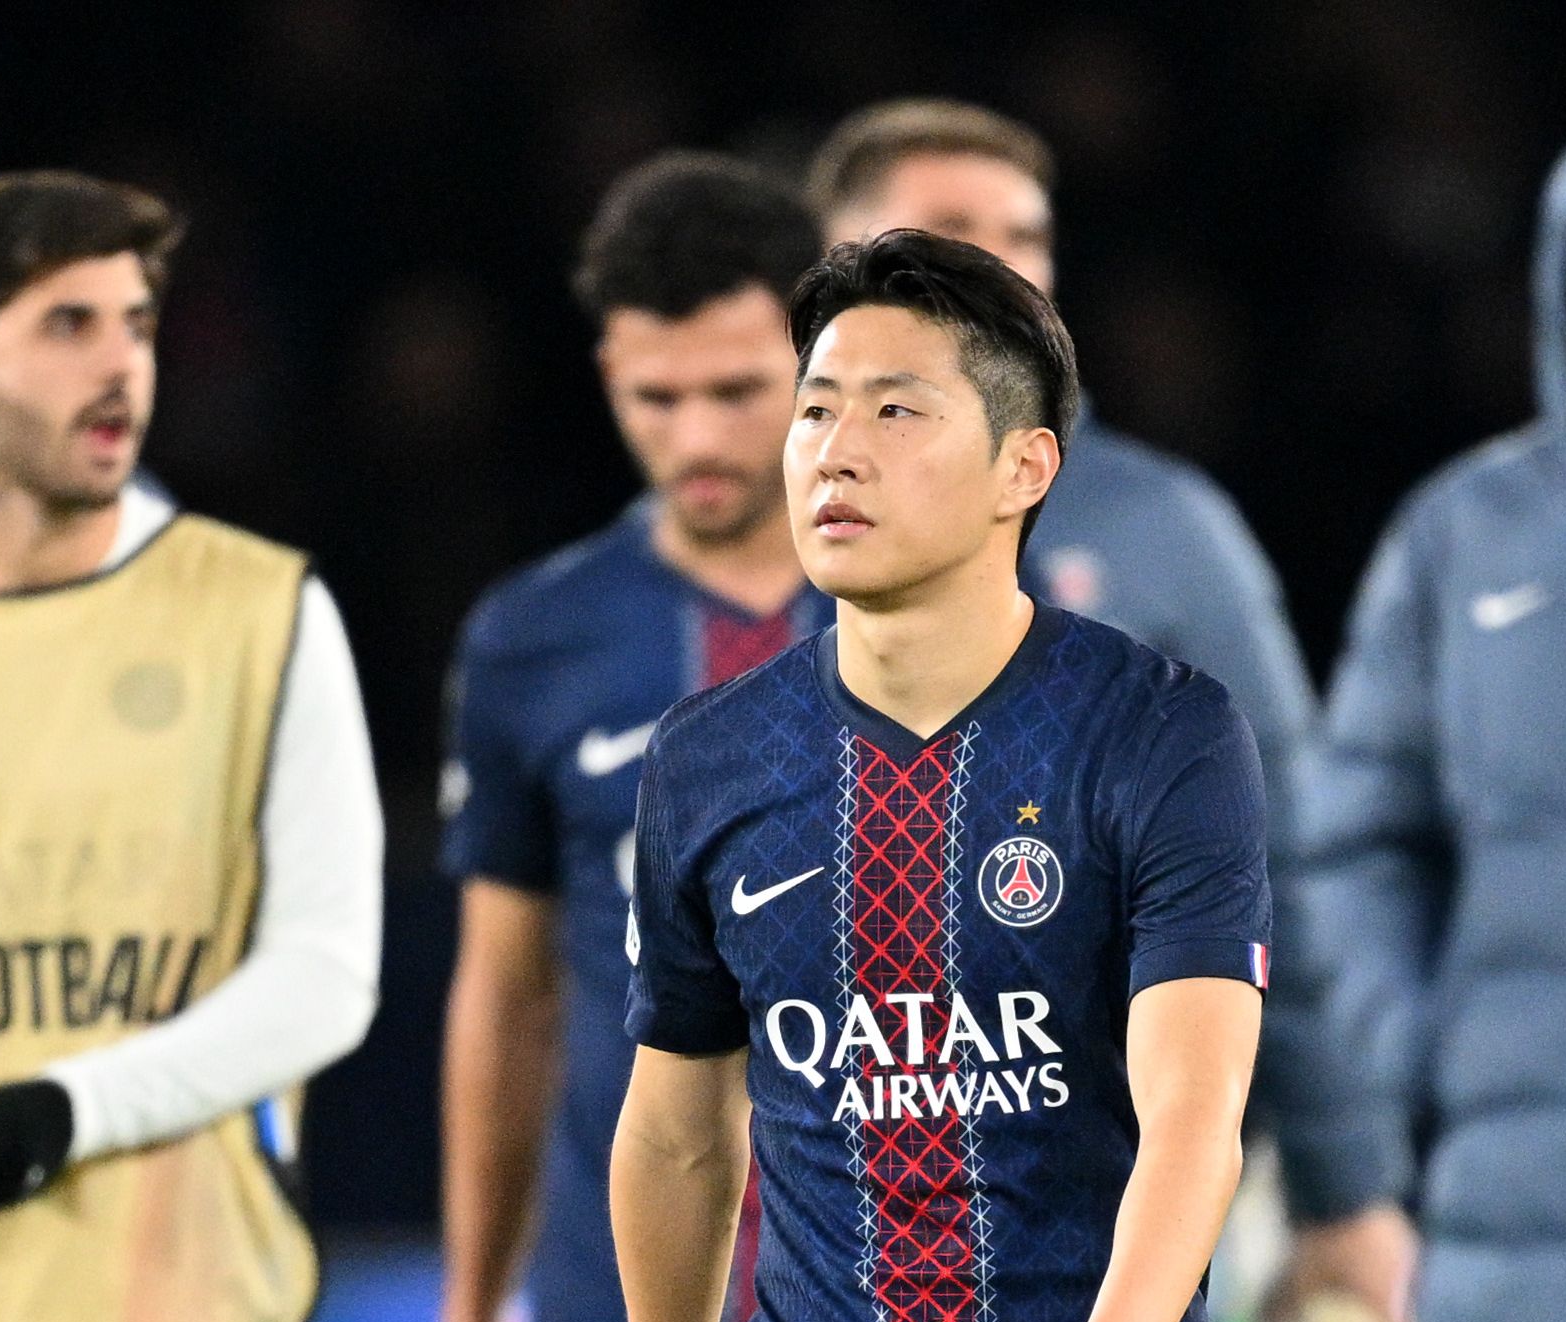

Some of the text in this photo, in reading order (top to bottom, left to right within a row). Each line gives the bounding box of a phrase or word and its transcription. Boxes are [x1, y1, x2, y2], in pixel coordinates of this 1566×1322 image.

[995, 842, 1050, 864] PARIS
[765, 990, 1063, 1089] QATAR
[831, 1061, 1070, 1122] AIRWAYS
